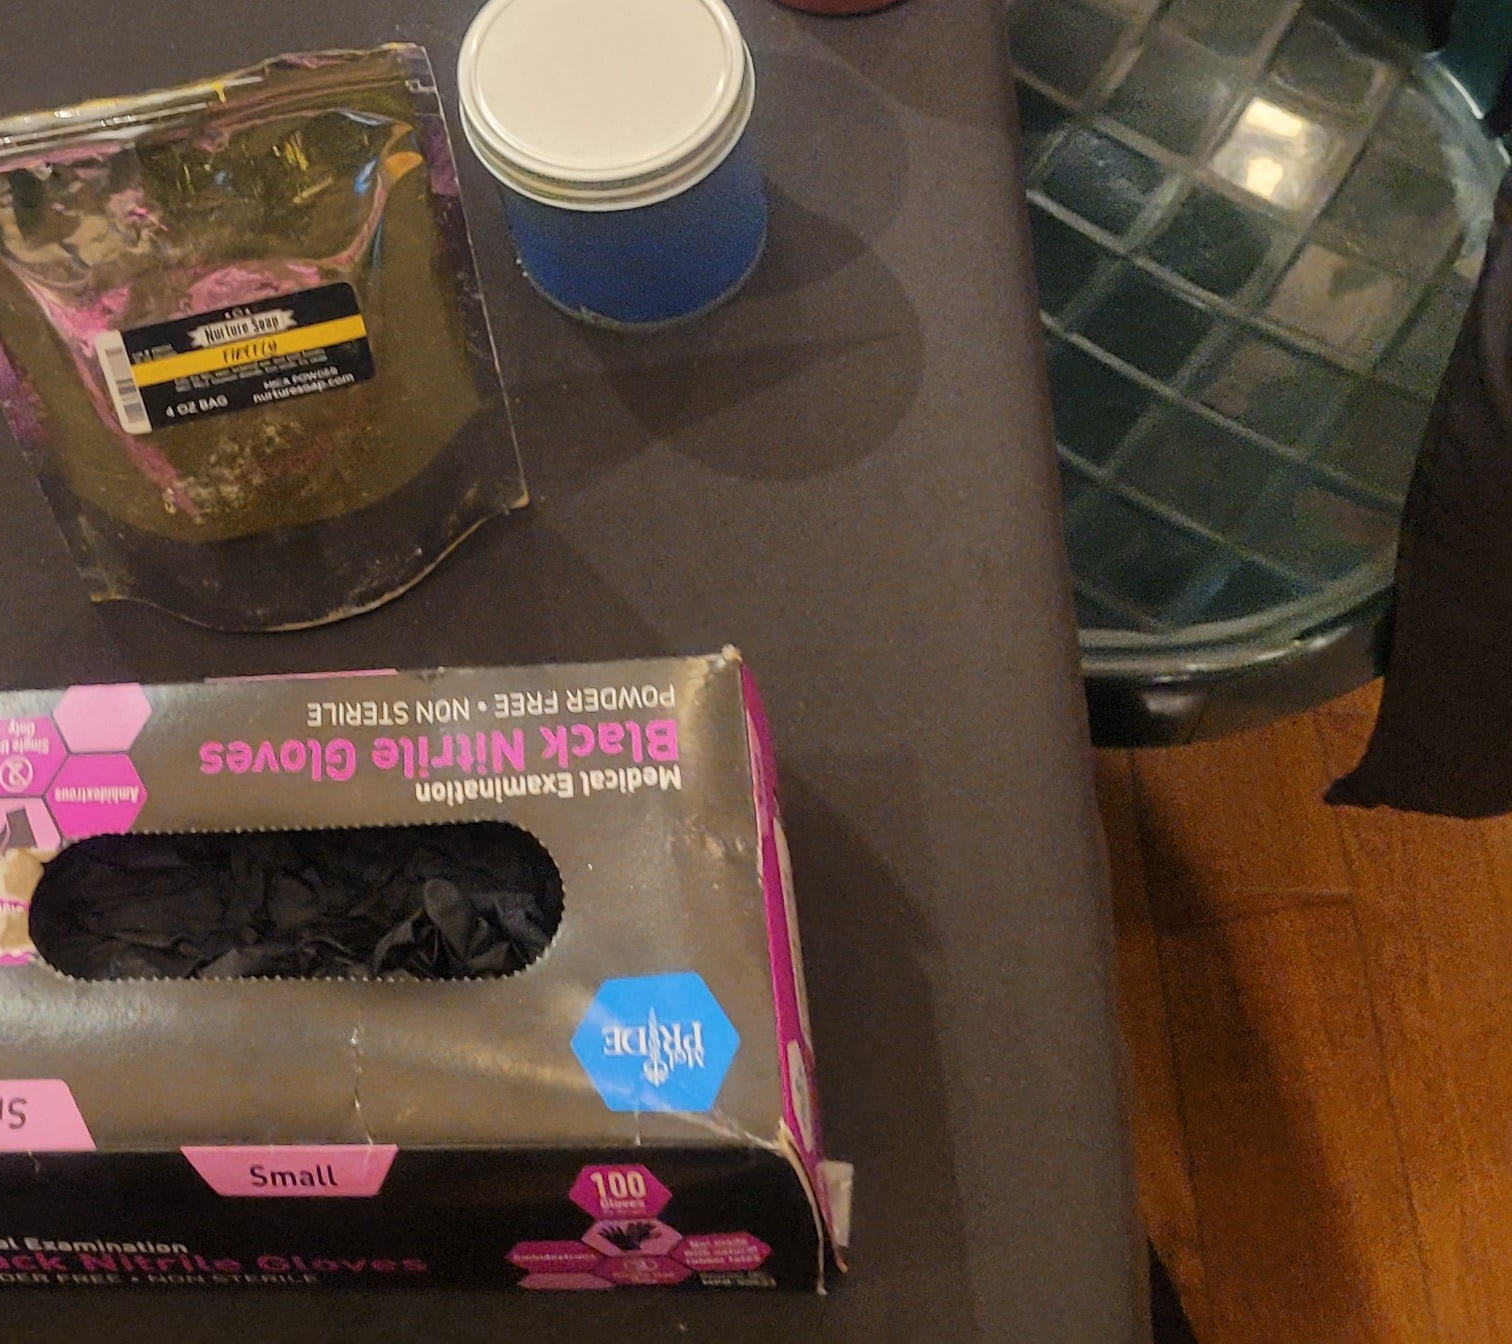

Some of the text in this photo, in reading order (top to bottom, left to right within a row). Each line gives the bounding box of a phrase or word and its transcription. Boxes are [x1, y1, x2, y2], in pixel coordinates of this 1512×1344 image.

[204, 314, 280, 345] Nurture Soap
[199, 393, 230, 413] BAG
[306, 684, 676, 728] POWDER FREE NON STERILE
[11, 736, 50, 755] Single
[198, 719, 680, 782] Black Nitrile Gloves
[54, 785, 139, 805] Ambidextrous
[413, 764, 683, 808] Medical Examination
[601, 1014, 704, 1074] PRIDE
[249, 1164, 339, 1190] Small
[590, 1171, 648, 1200] 100
[23, 1236, 188, 1254] Examination
[77, 1250, 242, 1273] Nitrile
[256, 1254, 428, 1274] Gloves
